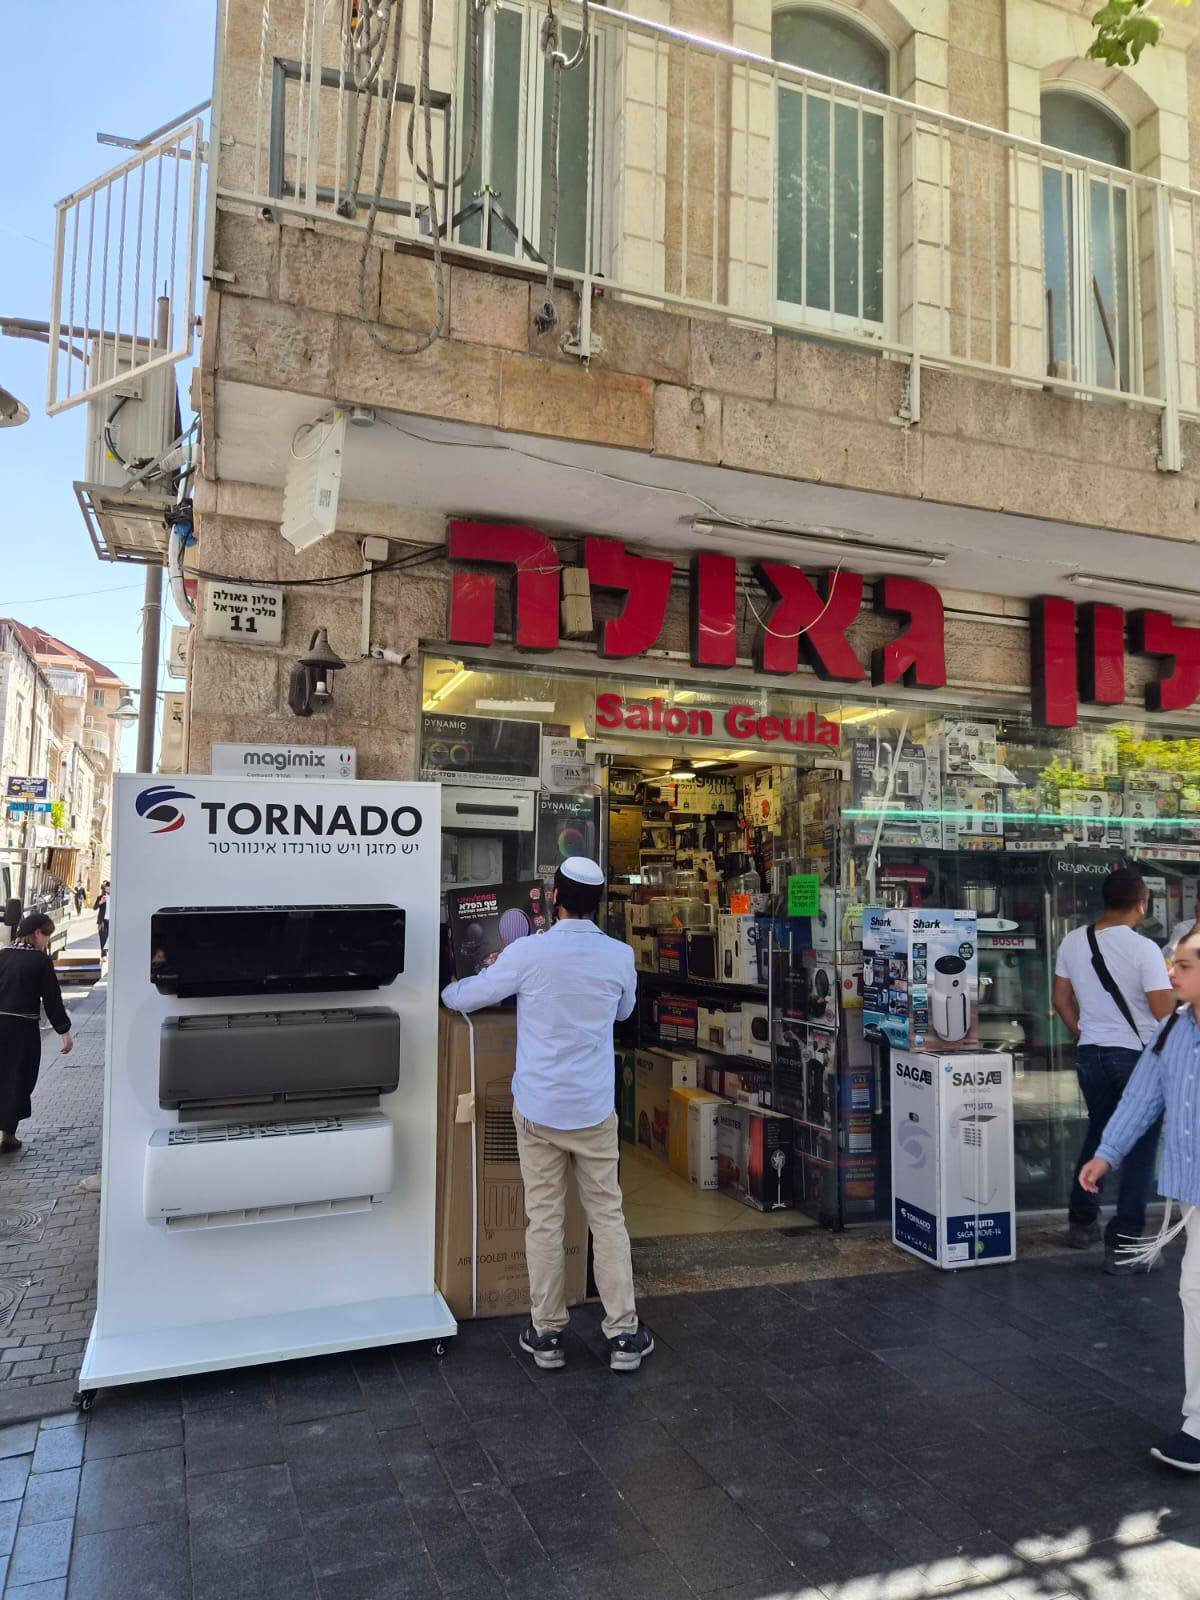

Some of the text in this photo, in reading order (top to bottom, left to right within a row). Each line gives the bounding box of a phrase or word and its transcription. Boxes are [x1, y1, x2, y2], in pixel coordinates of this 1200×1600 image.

[213, 590, 277, 606] סלון גאולה
[448, 518, 947, 689] גאולה
[213, 602, 276, 617] מלכי ישראל
[230, 615, 258, 632] 11
[424, 718, 467, 730] DYNAMIC
[596, 692, 840, 746] Salon Geula
[244, 750, 326, 770] magimix
[541, 802, 581, 810] DYNAMIC
[200, 802, 422, 836] TORNADO
[208, 842, 419, 856] יש מזגן ויש טורנדו אינוורטר
[1057, 862, 1112, 874] REMINGTON
[870, 916, 892, 928] Shark
[912, 919, 940, 928] Shark
[992, 938, 1024, 946] BOSCH
[896, 1062, 926, 1084] SAGA
[952, 1072, 995, 1087] SAGA
[907, 1213, 930, 1230] TORNADO
[956, 1230, 974, 1238] SAGA
[476, 1252, 508, 1264] OOLER
